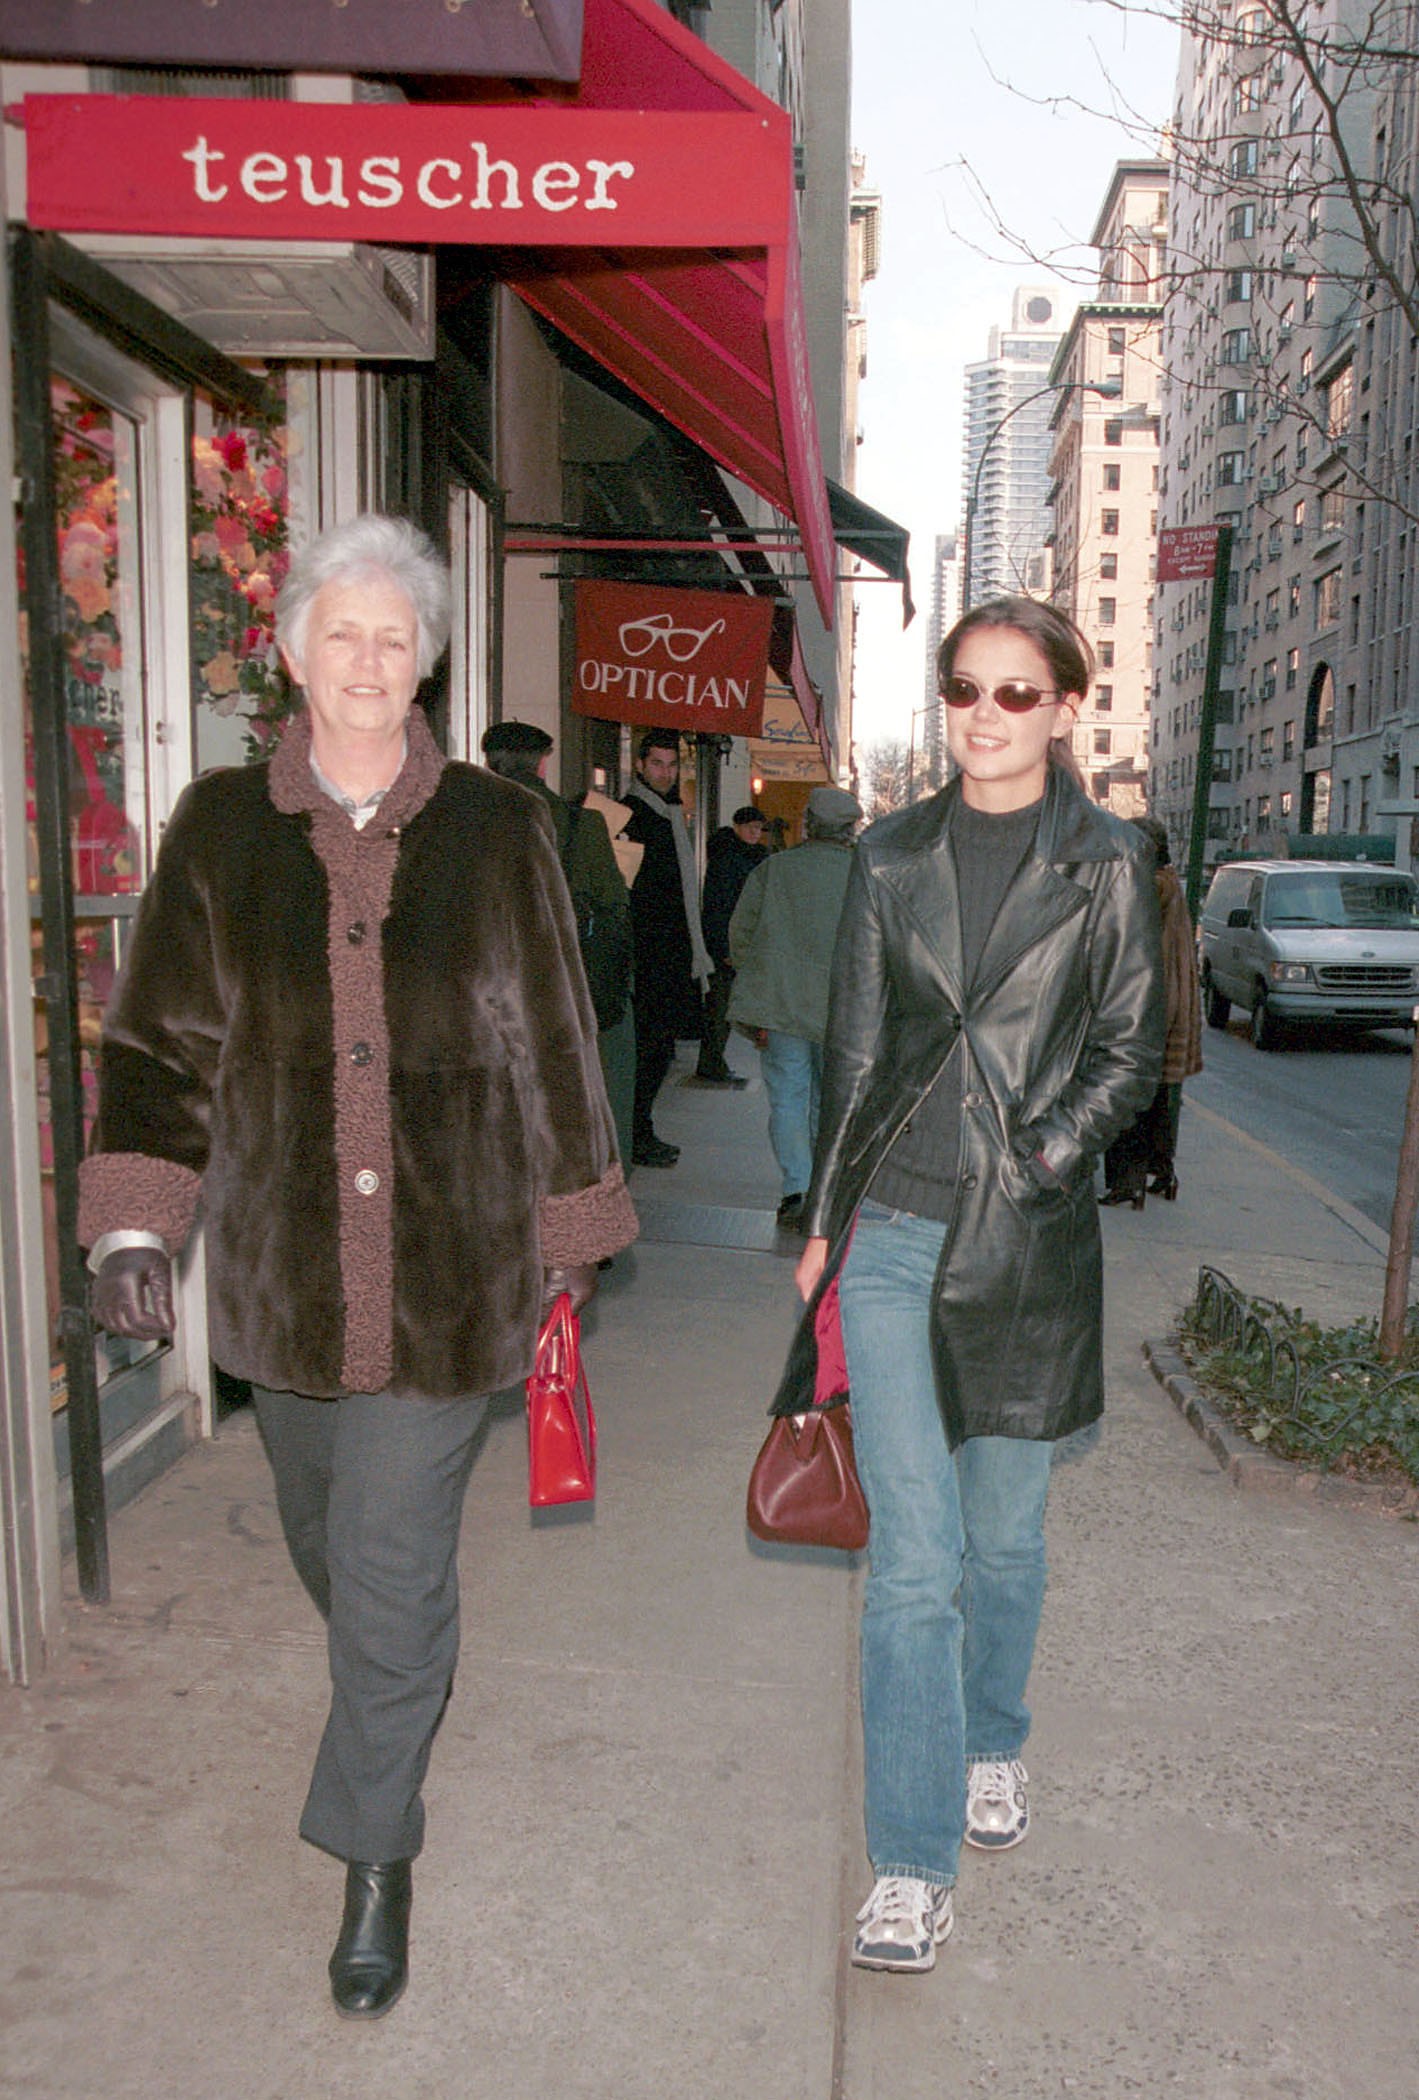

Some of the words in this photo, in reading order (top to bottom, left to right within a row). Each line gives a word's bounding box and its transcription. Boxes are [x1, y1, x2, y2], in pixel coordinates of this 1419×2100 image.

[181, 135, 635, 212] teuscher
[1162, 534, 1176, 545] NO
[579, 659, 750, 709] OPTICIAN
